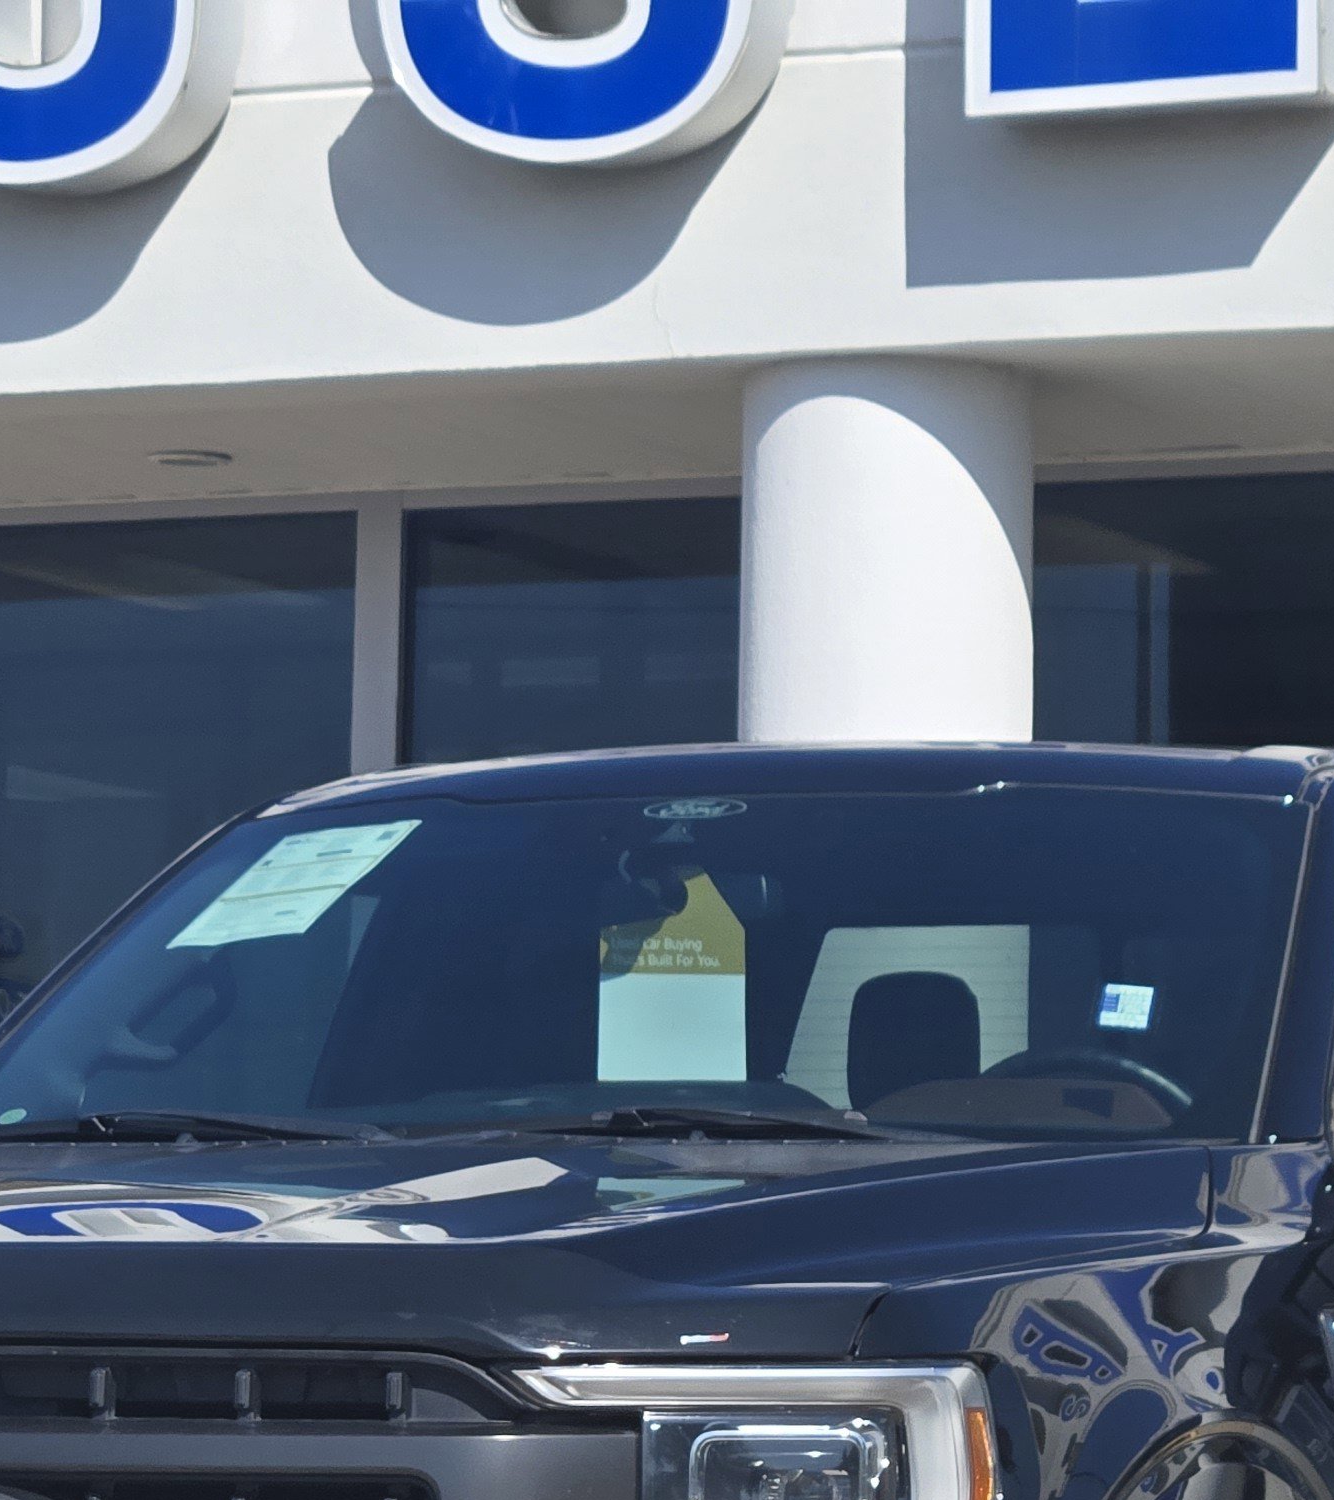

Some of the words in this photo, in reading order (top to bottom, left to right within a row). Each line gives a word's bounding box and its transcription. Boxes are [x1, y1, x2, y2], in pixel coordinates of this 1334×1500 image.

[664, 938, 703, 953] Buying
[648, 954, 673, 967] Built
[676, 955, 694, 967] For
